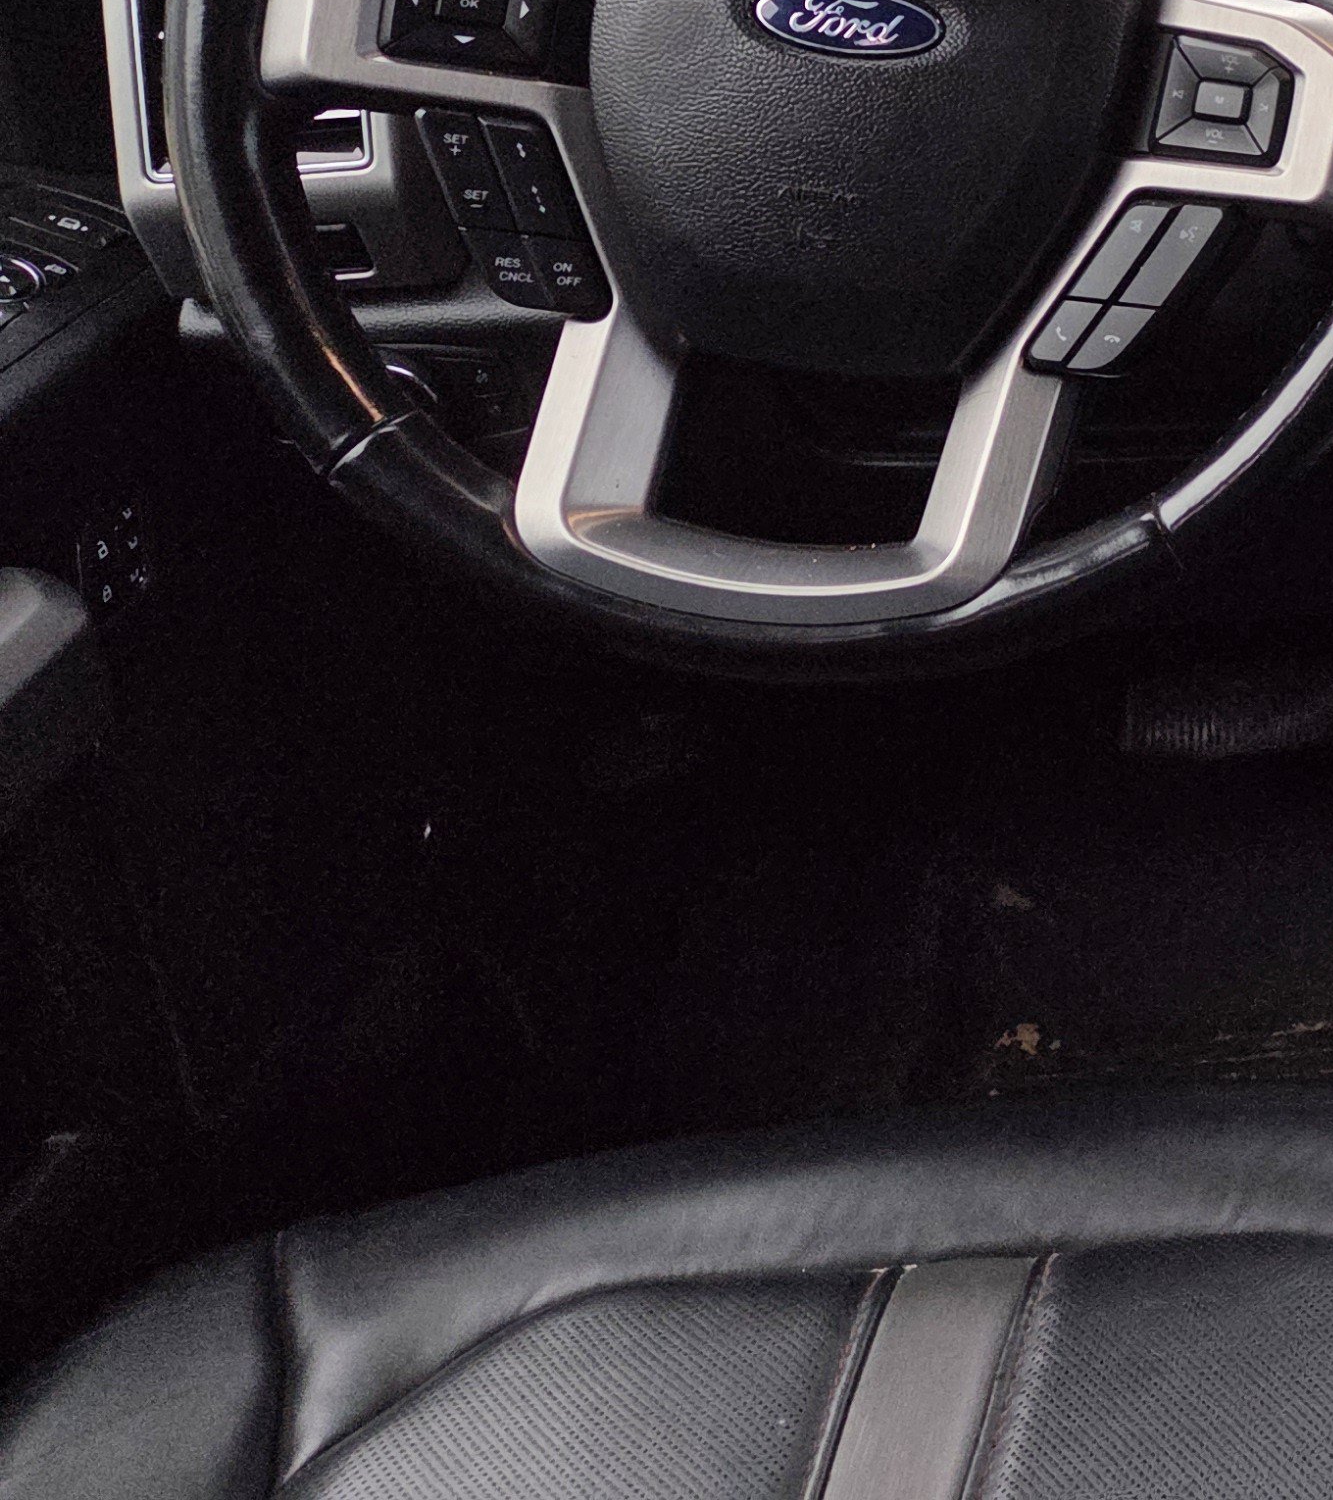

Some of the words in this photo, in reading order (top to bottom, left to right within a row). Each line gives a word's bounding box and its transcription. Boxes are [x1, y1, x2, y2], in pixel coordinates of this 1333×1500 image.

[443, 132, 469, 145] SET
[463, 188, 489, 201] SET
[494, 257, 522, 268] RES
[553, 262, 574, 273] ON
[499, 271, 534, 284] CNCL
[556, 276, 582, 287] OFF
